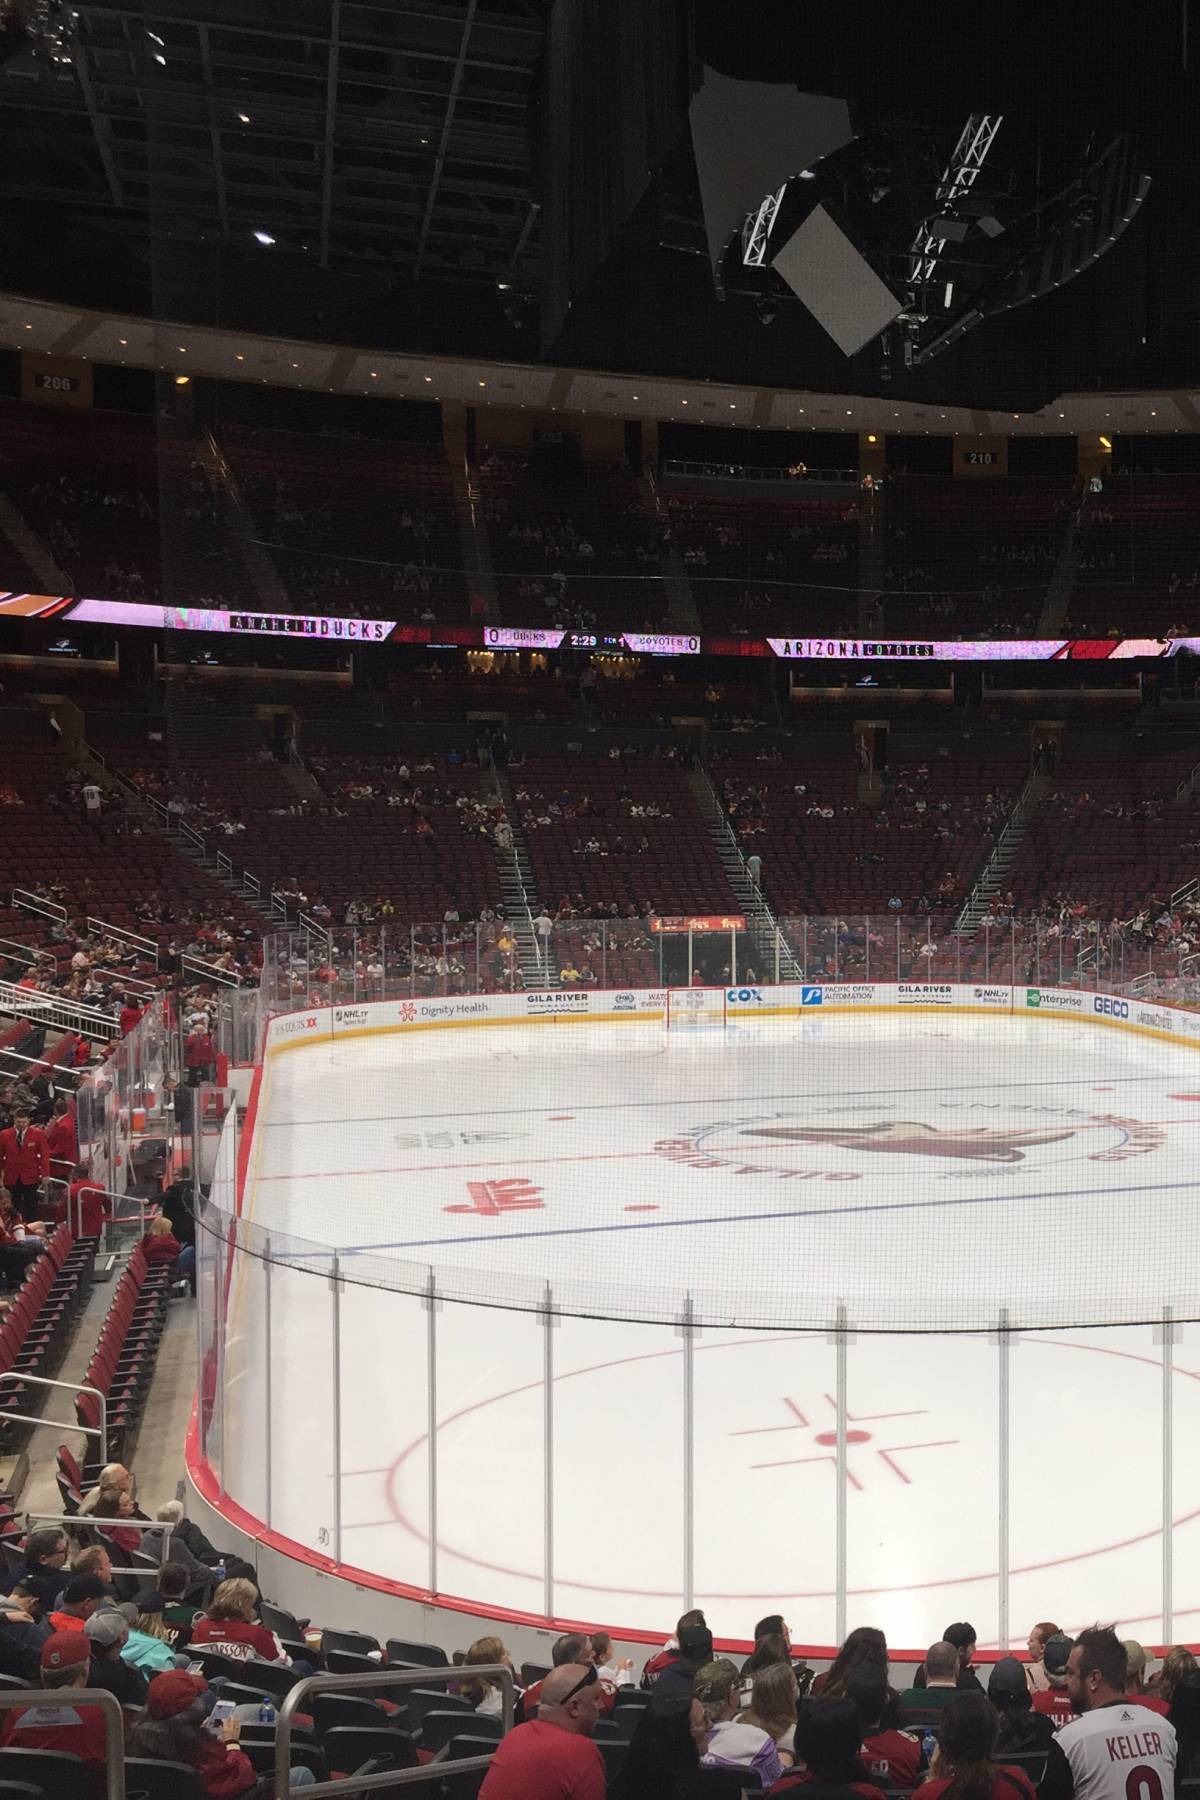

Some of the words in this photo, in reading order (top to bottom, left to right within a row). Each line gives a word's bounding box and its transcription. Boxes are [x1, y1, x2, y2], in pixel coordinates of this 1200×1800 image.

[43, 375, 71, 391] 206
[970, 452, 992, 465] 210
[235, 616, 314, 633] ANAHEIM
[320, 619, 384, 639] DUCKS
[489, 629, 499, 643] 0
[570, 634, 597, 647] 2:29
[688, 636, 698, 650] 0
[783, 639, 859, 657] ARIZONA
[866, 644, 932, 657] COYOTES
[727, 990, 763, 1003] COX
[824, 992, 873, 1000] AUTOMATION
[825, 986, 850, 994] PACIFIC
[853, 985, 876, 993] OFFICE
[898, 985, 922, 994] GILA
[923, 985, 952, 993] RIVER
[527, 995, 553, 1003] GILA
[555, 993, 588, 1002] RIVER
[421, 1006, 454, 1018] Dignity
[456, 1002, 488, 1013] Health
[1094, 996, 1129, 1019] GEICO
[1106, 1731, 1163, 1762] KELLER
